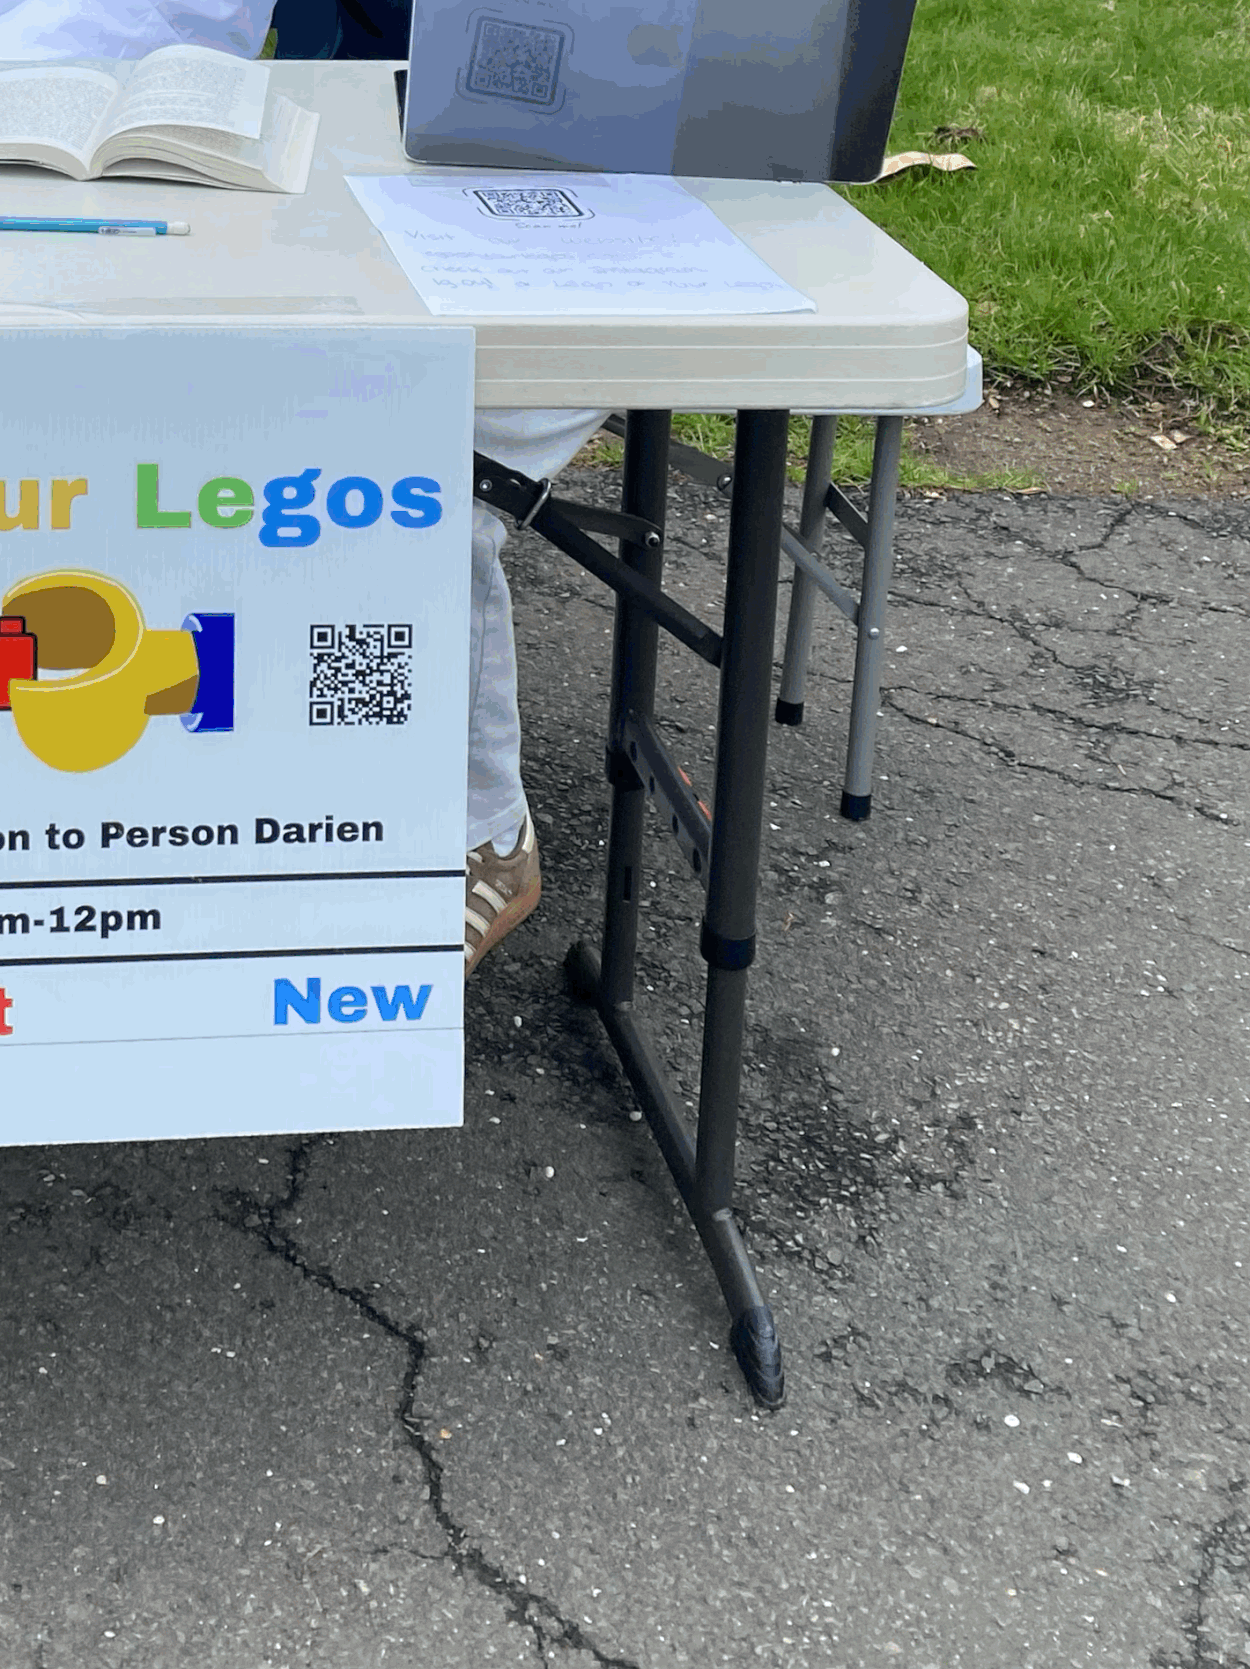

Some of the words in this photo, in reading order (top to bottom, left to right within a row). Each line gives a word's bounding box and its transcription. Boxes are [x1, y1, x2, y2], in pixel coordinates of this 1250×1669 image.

[136, 463, 443, 548] Legos
[46, 824, 84, 849] to
[102, 822, 238, 848] Person
[256, 816, 382, 843] Darien
[273, 977, 433, 1026] New
